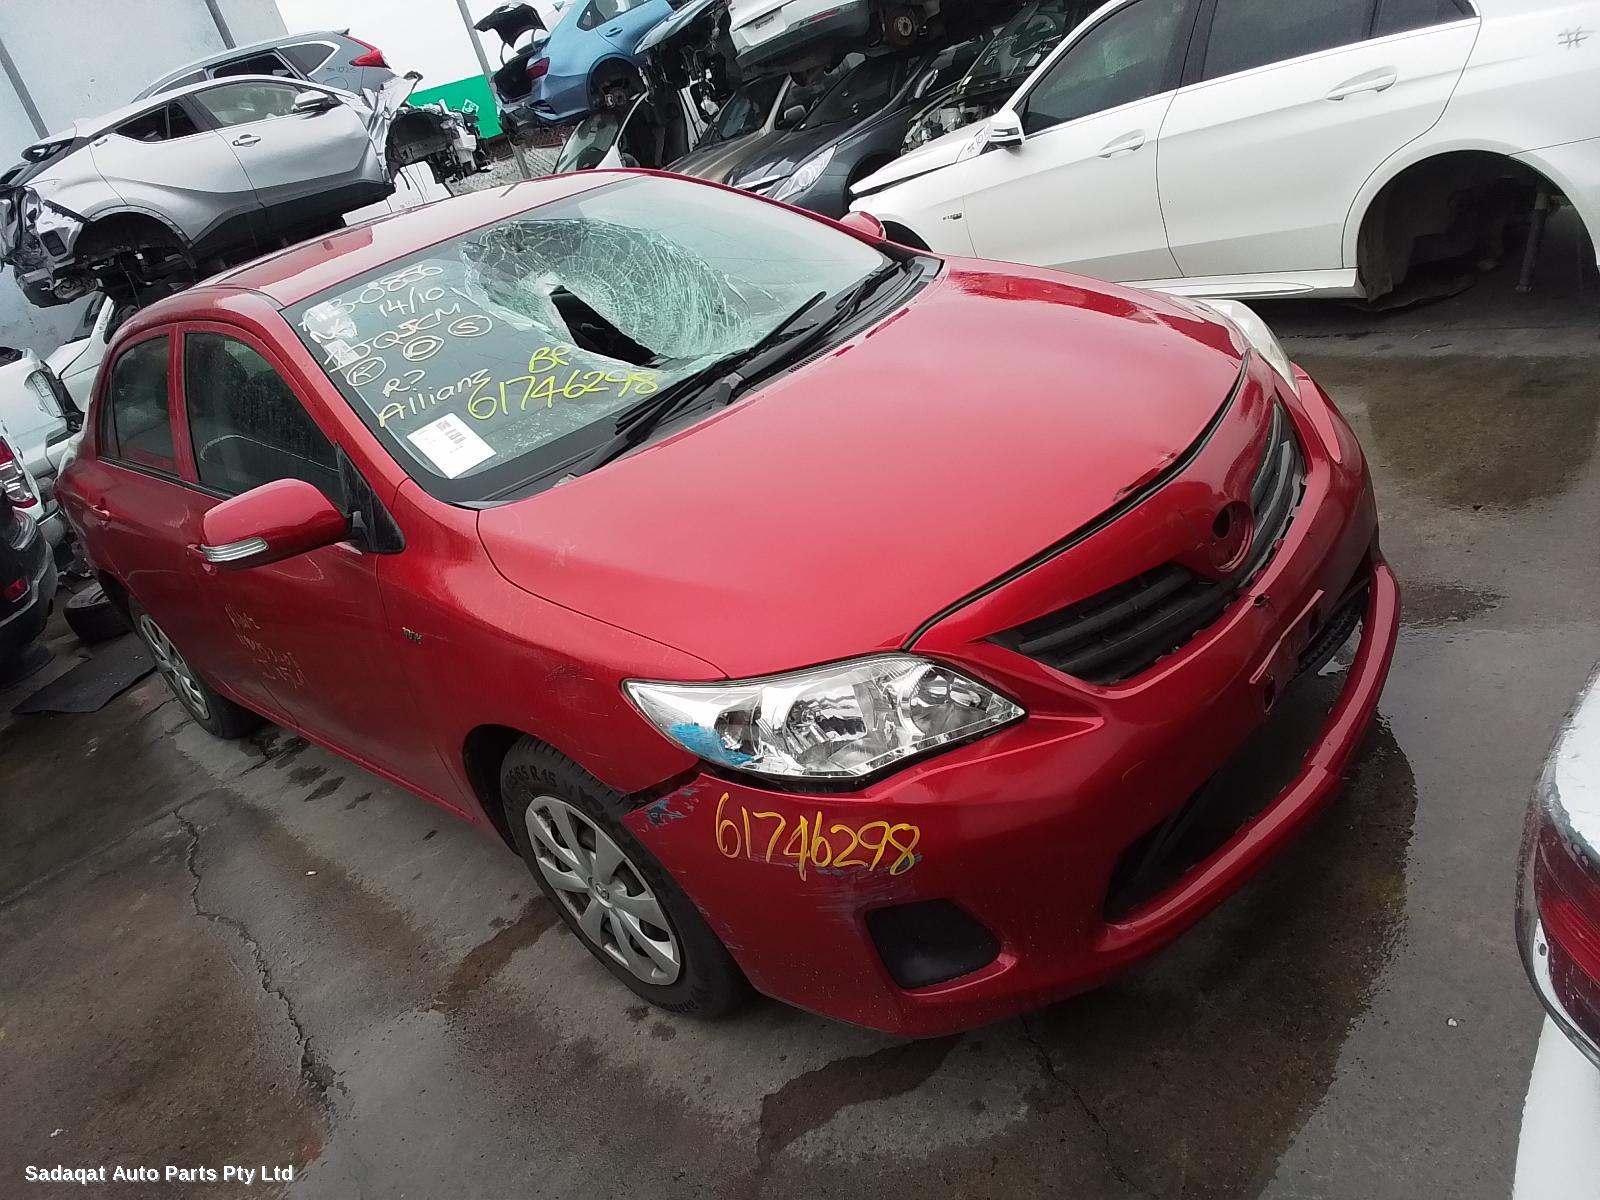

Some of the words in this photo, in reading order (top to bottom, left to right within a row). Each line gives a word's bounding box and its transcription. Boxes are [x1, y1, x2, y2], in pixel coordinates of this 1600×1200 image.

[379, 286, 445, 318] 14/10
[379, 368, 491, 428] Allianz
[467, 369, 659, 420] 61746298
[715, 792, 921, 881] 61746298
